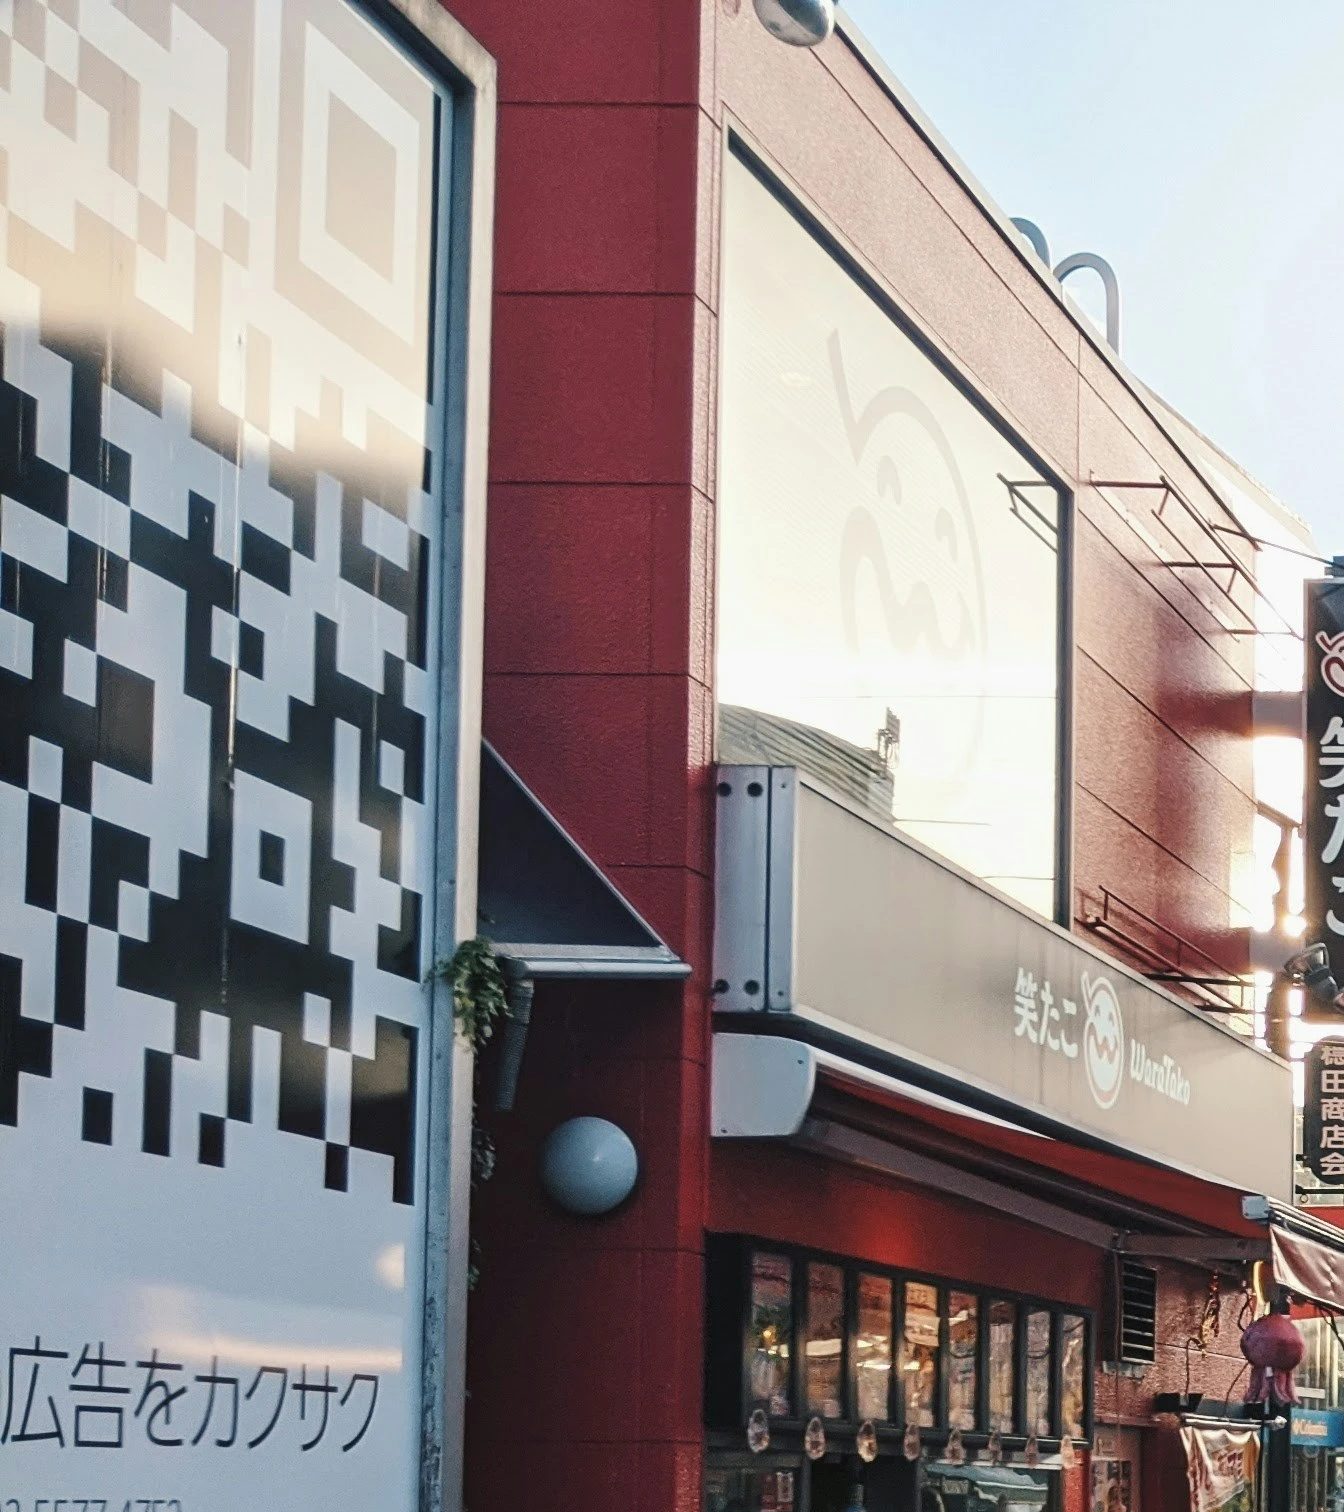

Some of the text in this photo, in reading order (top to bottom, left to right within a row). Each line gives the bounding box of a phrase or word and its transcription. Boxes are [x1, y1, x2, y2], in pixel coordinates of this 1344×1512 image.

[1014, 967, 1078, 1058] 笑たこ
[1130, 1038, 1191, 1105] WaraTako
